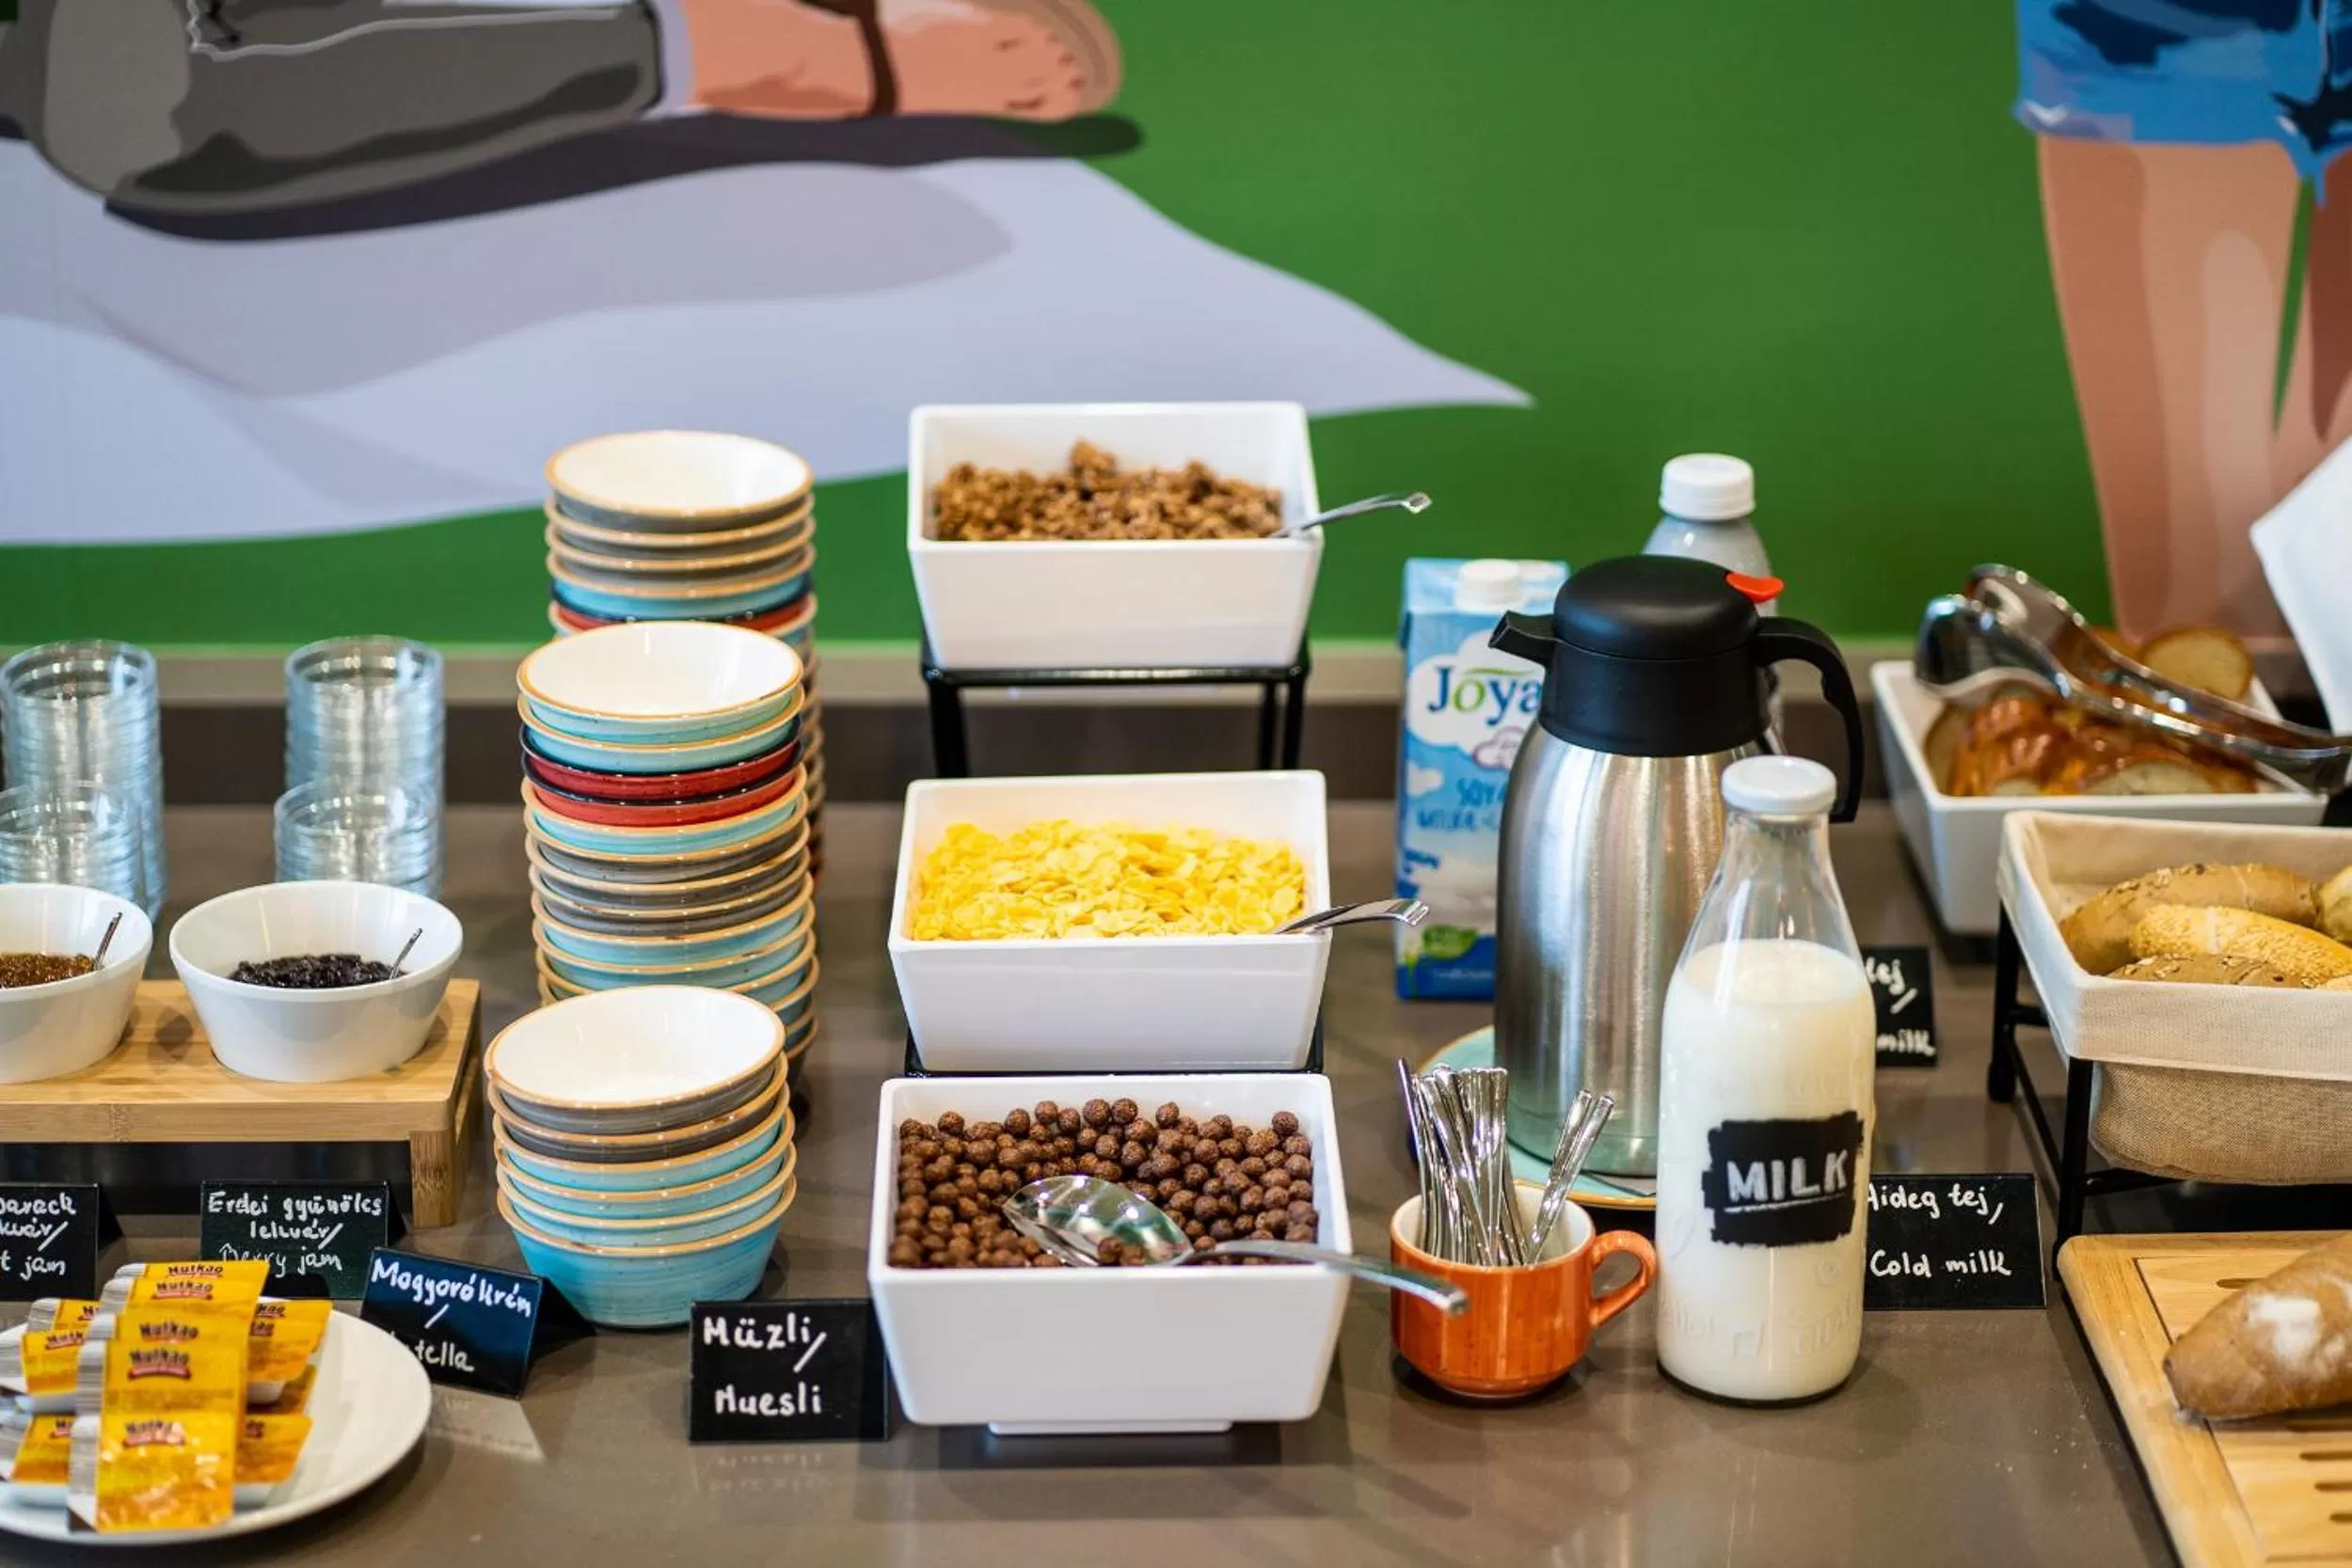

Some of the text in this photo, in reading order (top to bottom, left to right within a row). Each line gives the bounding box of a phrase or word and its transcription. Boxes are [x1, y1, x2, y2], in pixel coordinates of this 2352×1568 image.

[1426, 665, 1543, 727] Joya
[1726, 1148, 1849, 1203] MILK
[207, 1190, 270, 1216] Erdei
[20, 1255, 66, 1281] jam
[297, 1244, 343, 1275] jam
[1869, 1248, 2012, 1278] Cold milk
[371, 1258, 532, 1318] Mogyorókrém
[410, 1338, 475, 1373] tella
